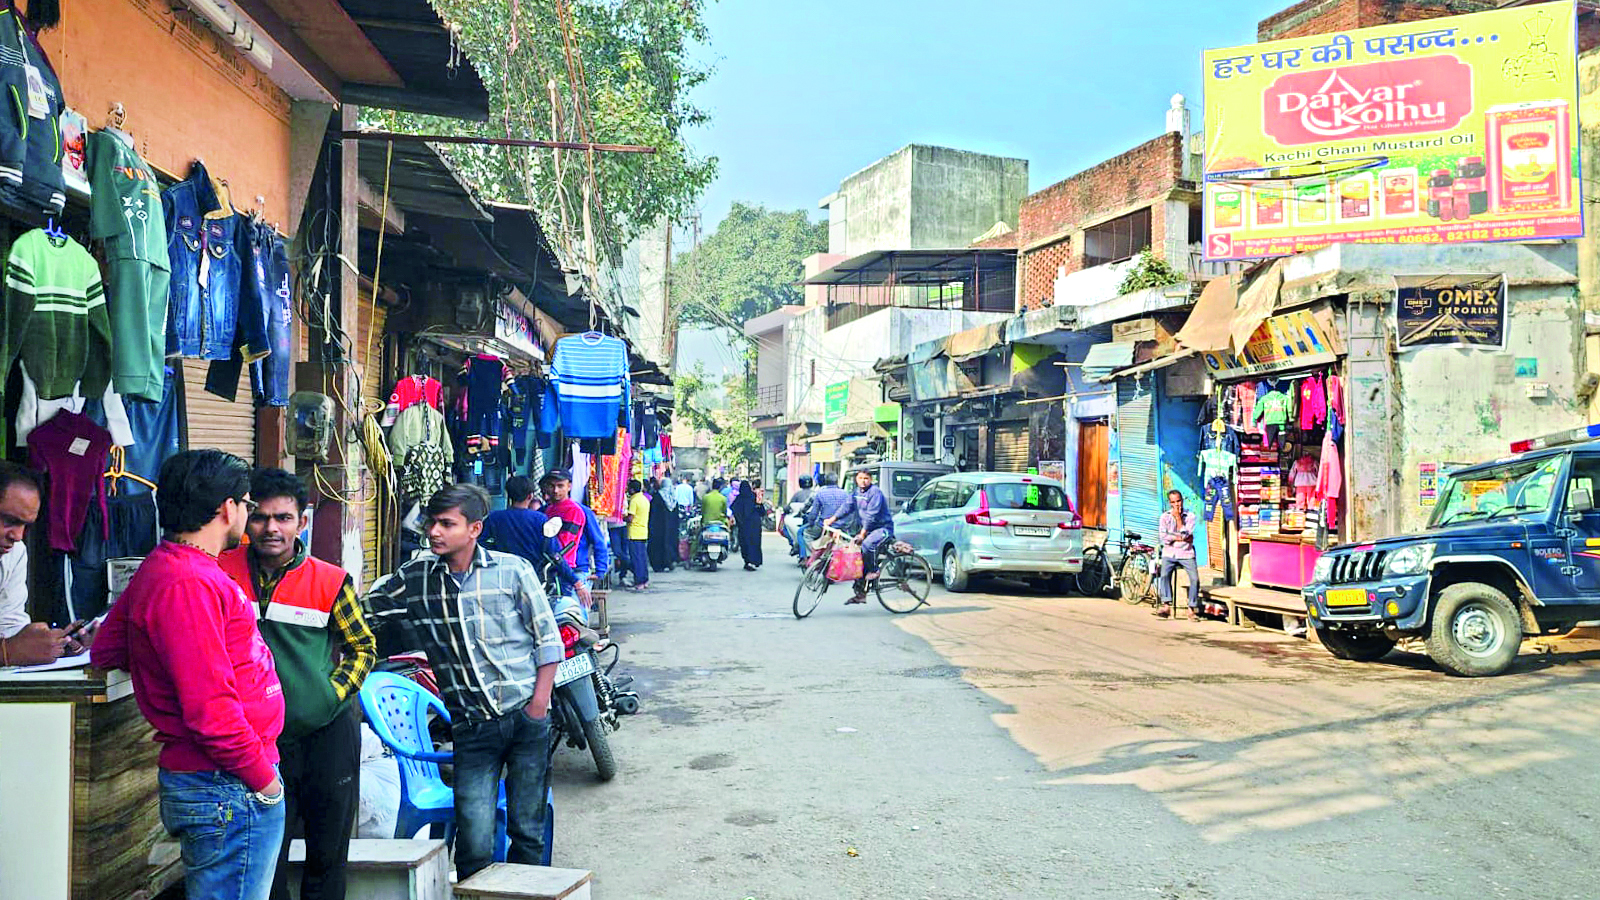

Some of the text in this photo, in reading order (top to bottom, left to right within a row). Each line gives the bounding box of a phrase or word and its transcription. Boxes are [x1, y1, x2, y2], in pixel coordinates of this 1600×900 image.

[1212, 54, 1255, 79] हर
[1260, 48, 1304, 69] घर
[1310, 34, 1356, 63] की
[1276, 76, 1414, 113] Darvar
[1333, 100, 1446, 130] Kolhu
[1264, 133, 1475, 163] Kachi Ghani Mustard Oil
[1399, 233, 1443, 243] 60662,
[1446, 229, 1489, 240] 82182
[1245, 246, 1265, 255] For
[1269, 244, 1292, 255] Any
[1438, 289, 1498, 306] OMEX
[1438, 306, 1498, 314] EMPORIUM
[294, 611, 319, 623] FILA
